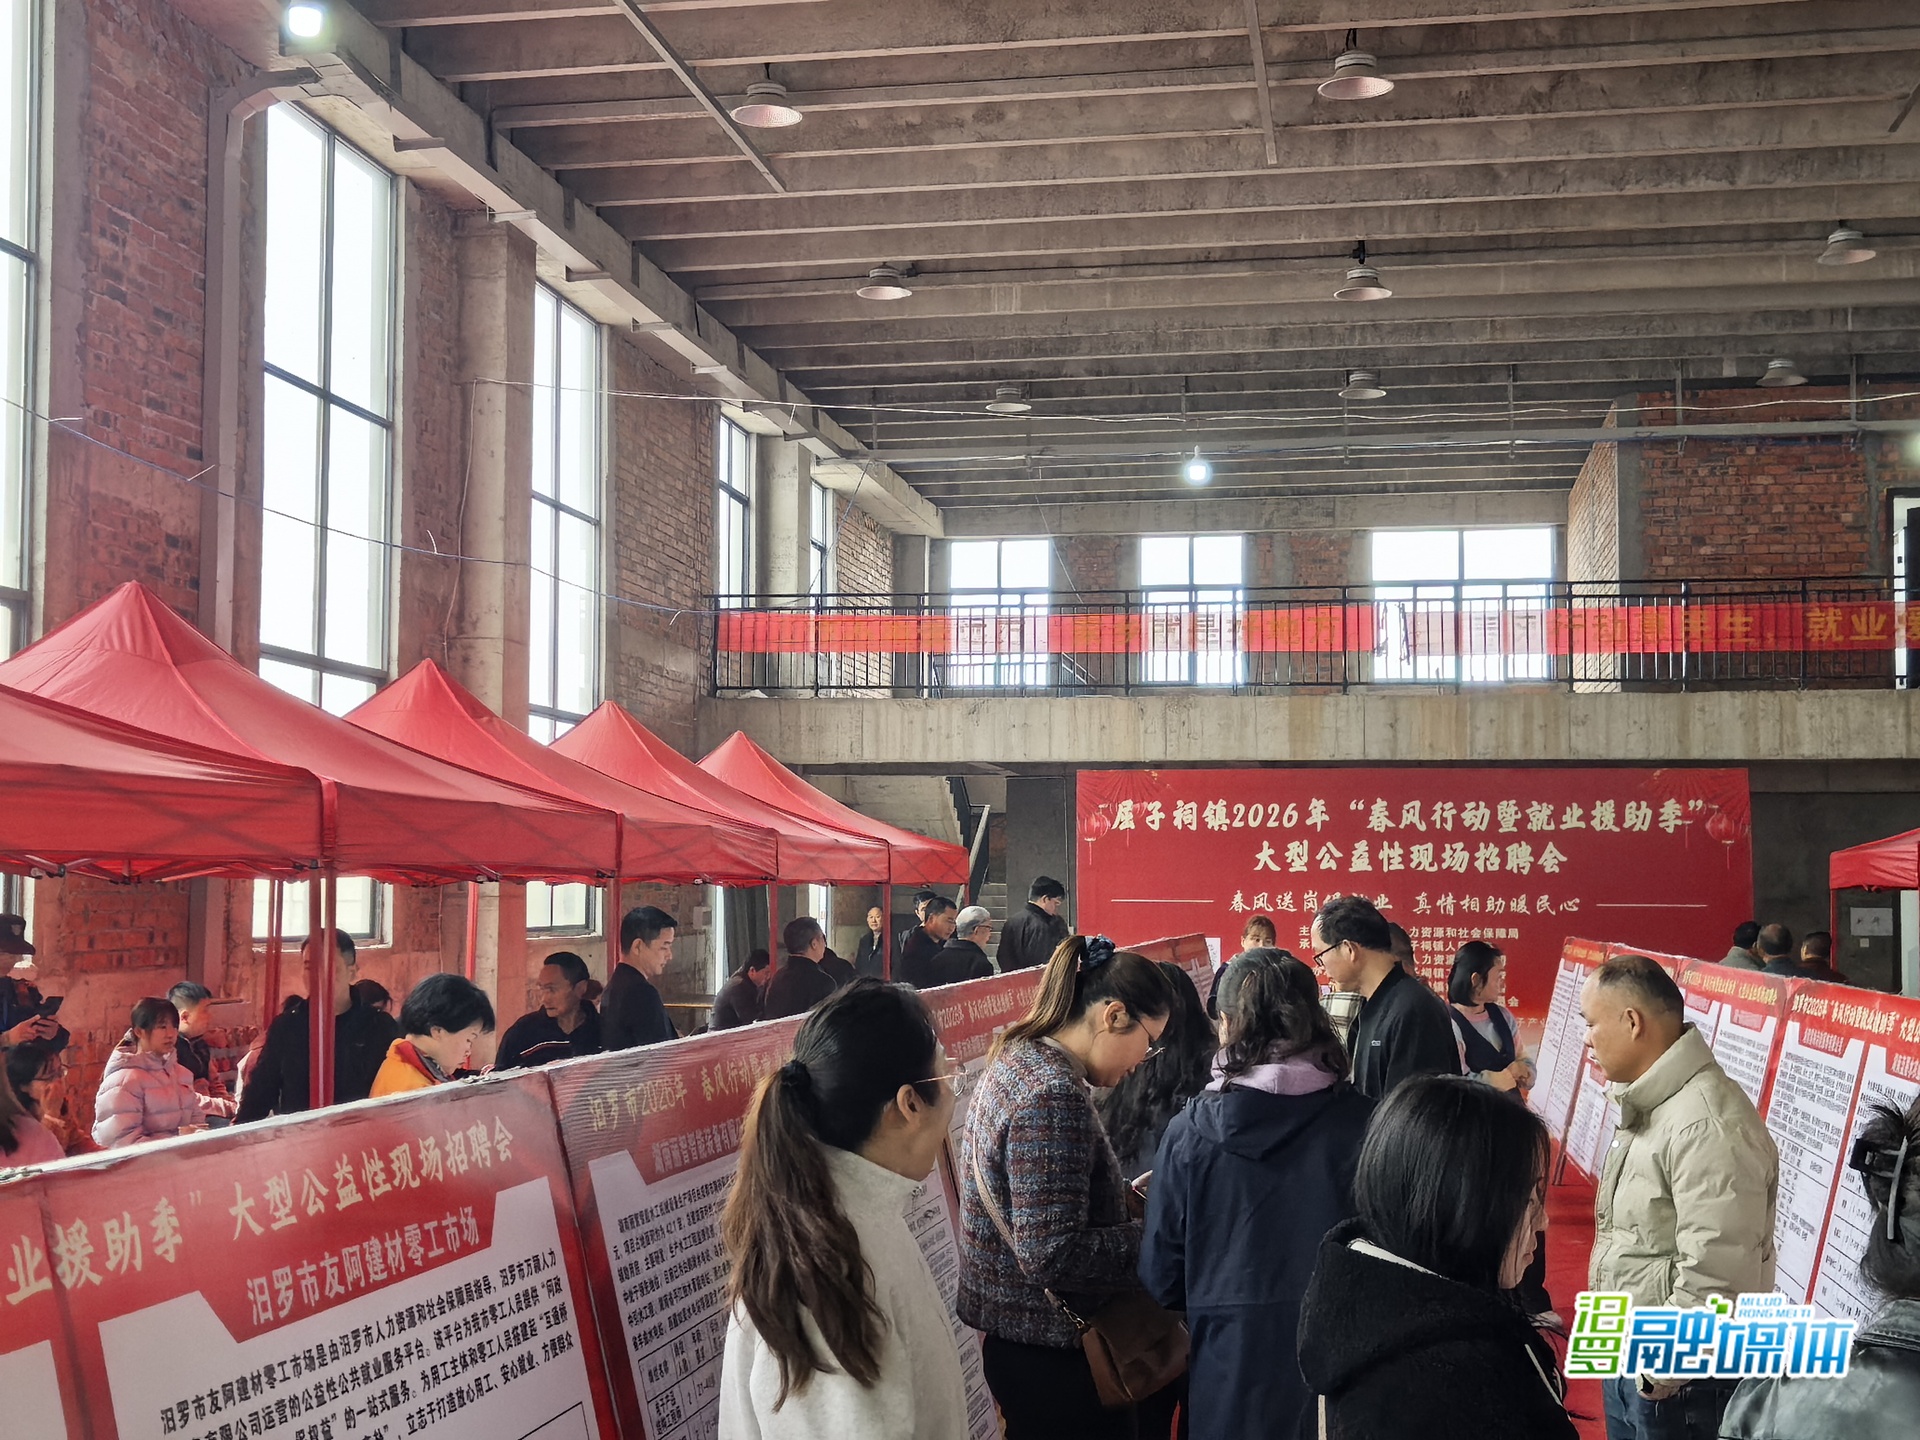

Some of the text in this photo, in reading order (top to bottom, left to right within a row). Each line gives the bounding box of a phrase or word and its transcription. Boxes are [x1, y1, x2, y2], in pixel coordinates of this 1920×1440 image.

[1111, 798, 1703, 834] 屈子祠镇2026年“春风行动暨就业援助季”
[1254, 839, 1568, 875] 大型公益性现场招聘会
[1229, 890, 1580, 915] 春风送岗业 真情相助暖民心
[247, 1206, 480, 1326] 汨罗市友阿建材零工市场
